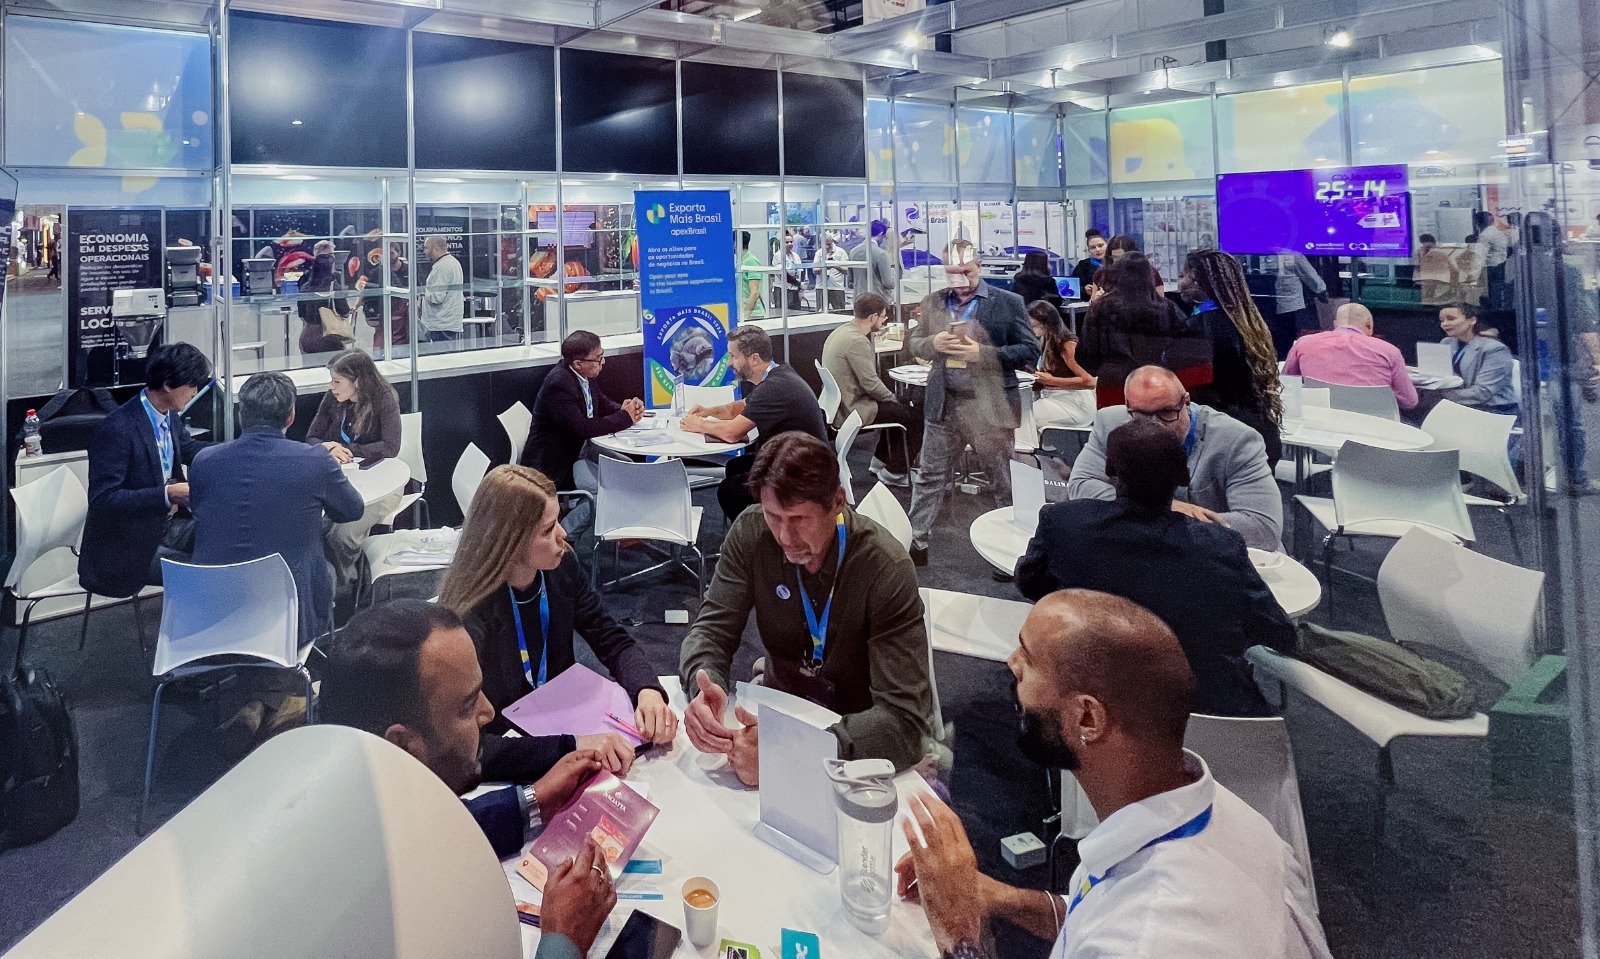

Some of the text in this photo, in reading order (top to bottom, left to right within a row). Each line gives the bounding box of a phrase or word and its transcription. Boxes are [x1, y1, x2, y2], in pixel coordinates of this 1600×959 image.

[669, 203, 706, 214] Exporta
[670, 213, 722, 224] Mais Brasil
[80, 234, 148, 245] ECONOMIA
[80, 244, 149, 253] EM DESPESAS
[80, 253, 149, 262] OPERACIONAIS
[80, 306, 113, 316] SERV
[677, 308, 691, 316] MAIS
[693, 308, 713, 320] BRASIL
